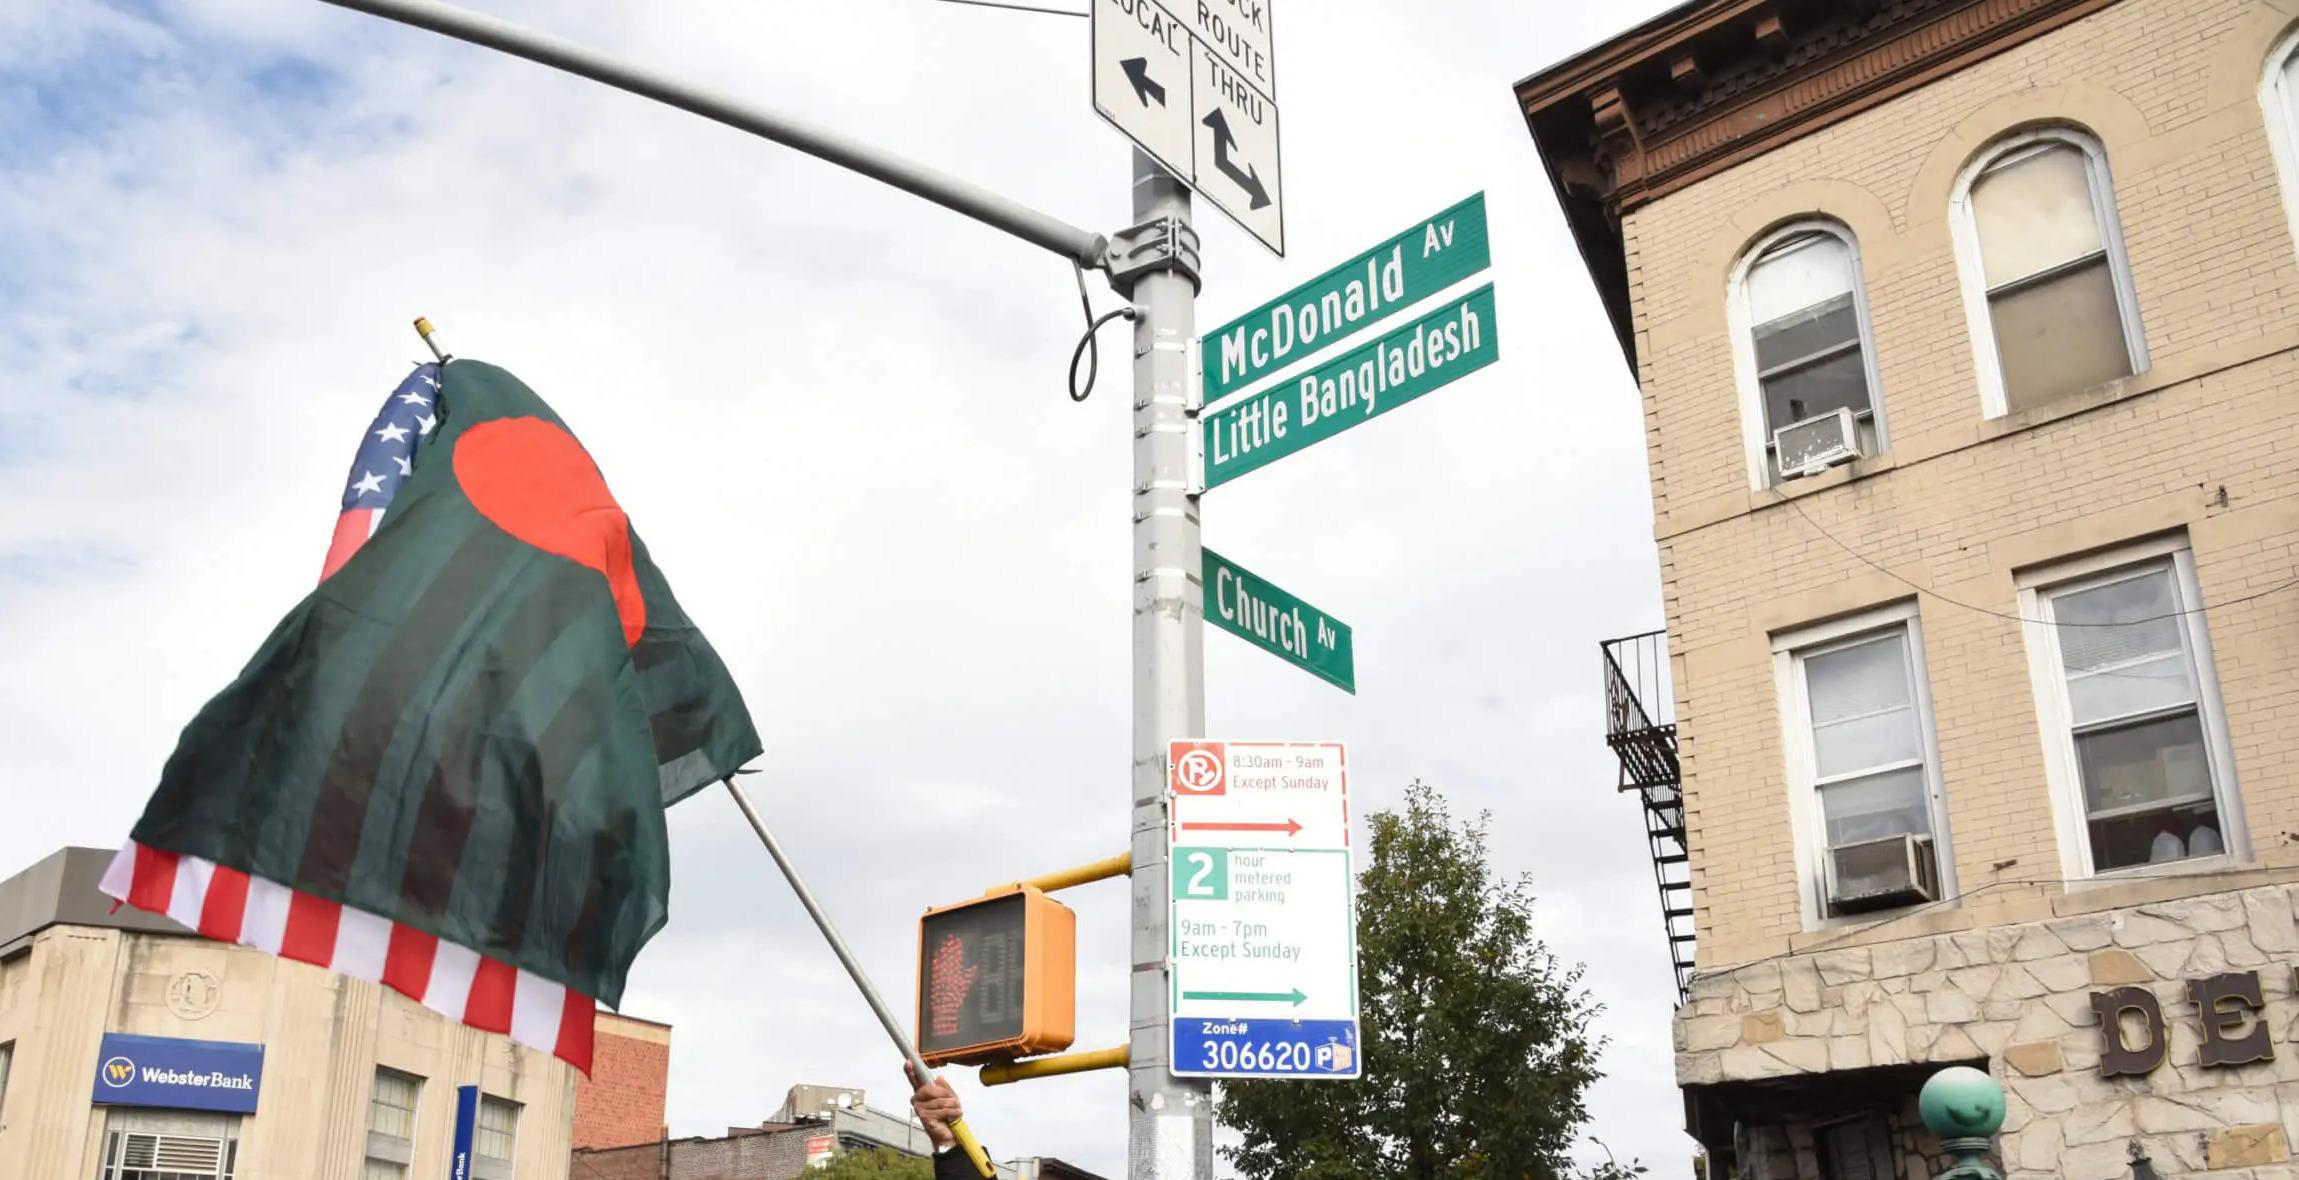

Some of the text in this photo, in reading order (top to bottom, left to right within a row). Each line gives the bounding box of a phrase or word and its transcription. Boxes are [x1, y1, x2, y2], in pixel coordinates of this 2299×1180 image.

[1112, 0, 1181, 56] OCAL
[1198, 0, 1266, 82] ROUTE
[1206, 55, 1263, 125] THRU
[1220, 219, 1455, 385] McDonald Av
[1213, 301, 1481, 466] Little Bangladesh
[1216, 566, 1336, 660] Church Av
[1232, 755, 1283, 769] 8:30am
[1295, 755, 1324, 769] 9am
[1232, 775, 1329, 791] Except Sunday
[1234, 854, 1266, 868] hour
[1187, 852, 1215, 896] 2
[1234, 871, 1292, 886] metered
[1235, 889, 1286, 905] parking
[1181, 919, 1216, 936] 9am
[1234, 920, 1268, 940] 7pm
[1181, 941, 1301, 962] Except Sunday
[1202, 1021, 1249, 1036] Zone#
[1202, 1040, 1311, 1071] 306620
[142, 1066, 253, 1090] WebsterBank
